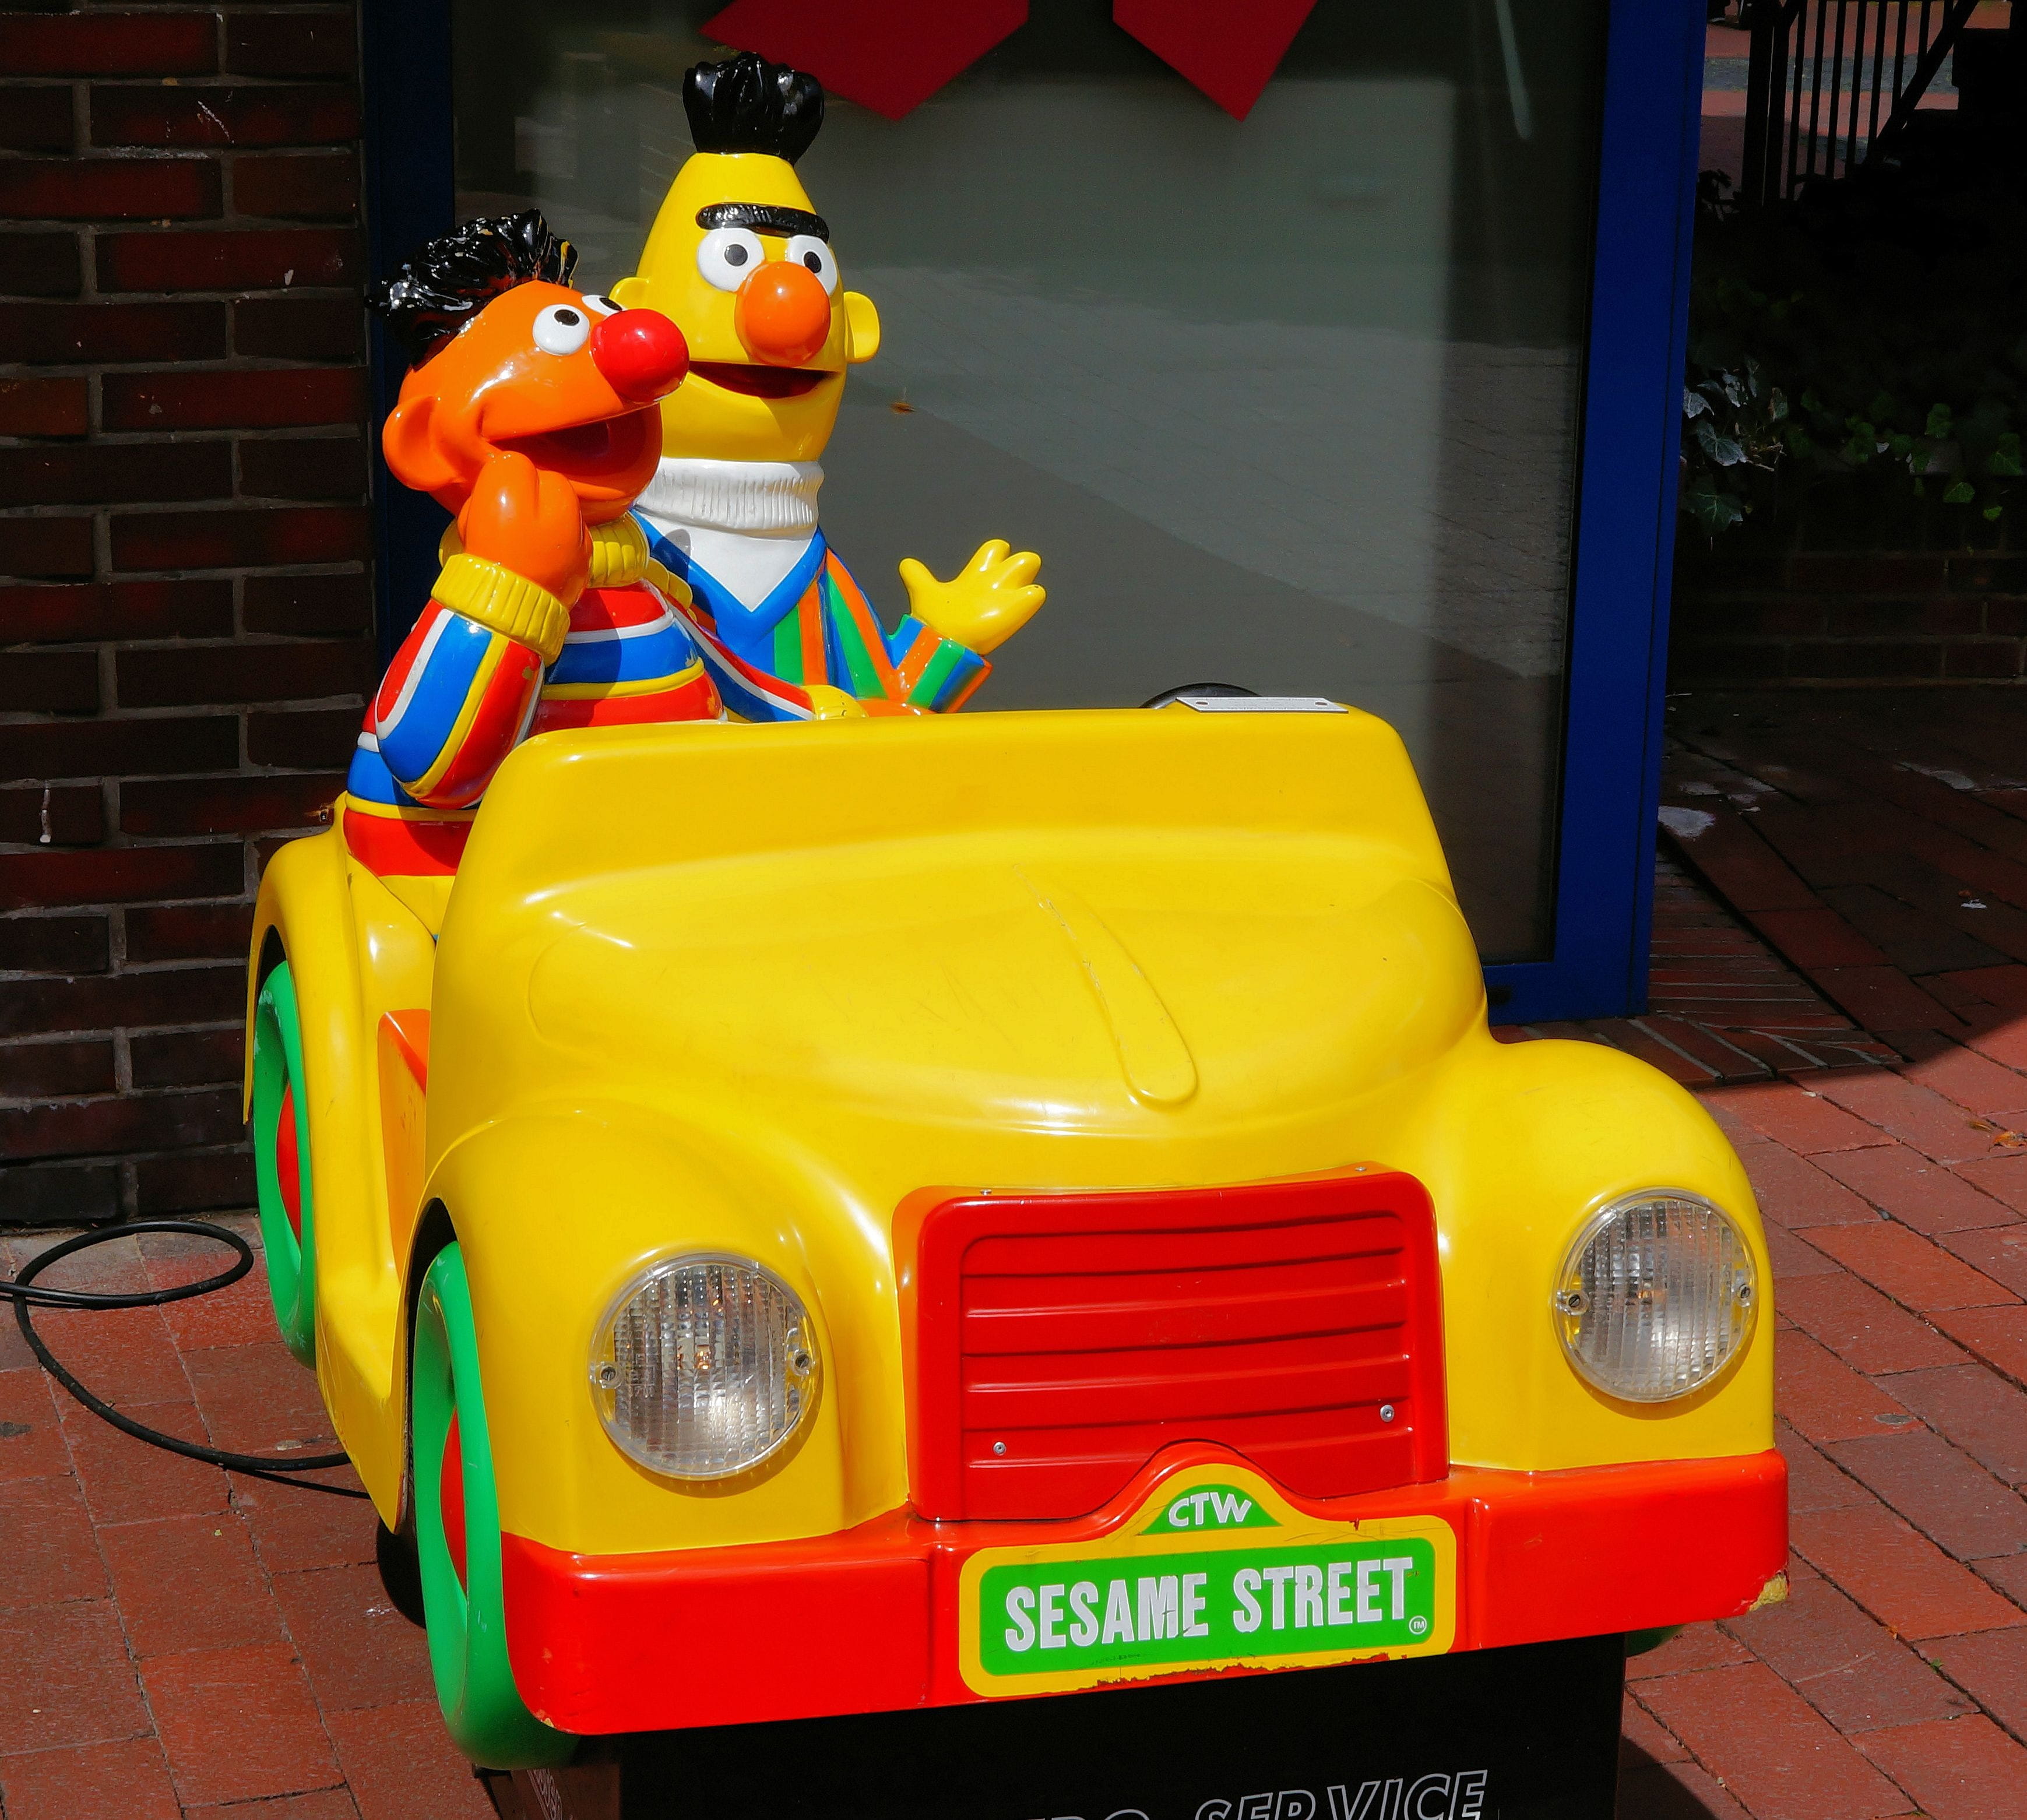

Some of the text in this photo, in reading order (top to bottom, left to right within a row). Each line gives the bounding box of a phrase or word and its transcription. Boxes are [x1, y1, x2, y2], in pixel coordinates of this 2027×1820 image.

[1169, 1492, 1252, 1527] CTW
[1005, 1557, 1413, 1652] SESAME STREET
